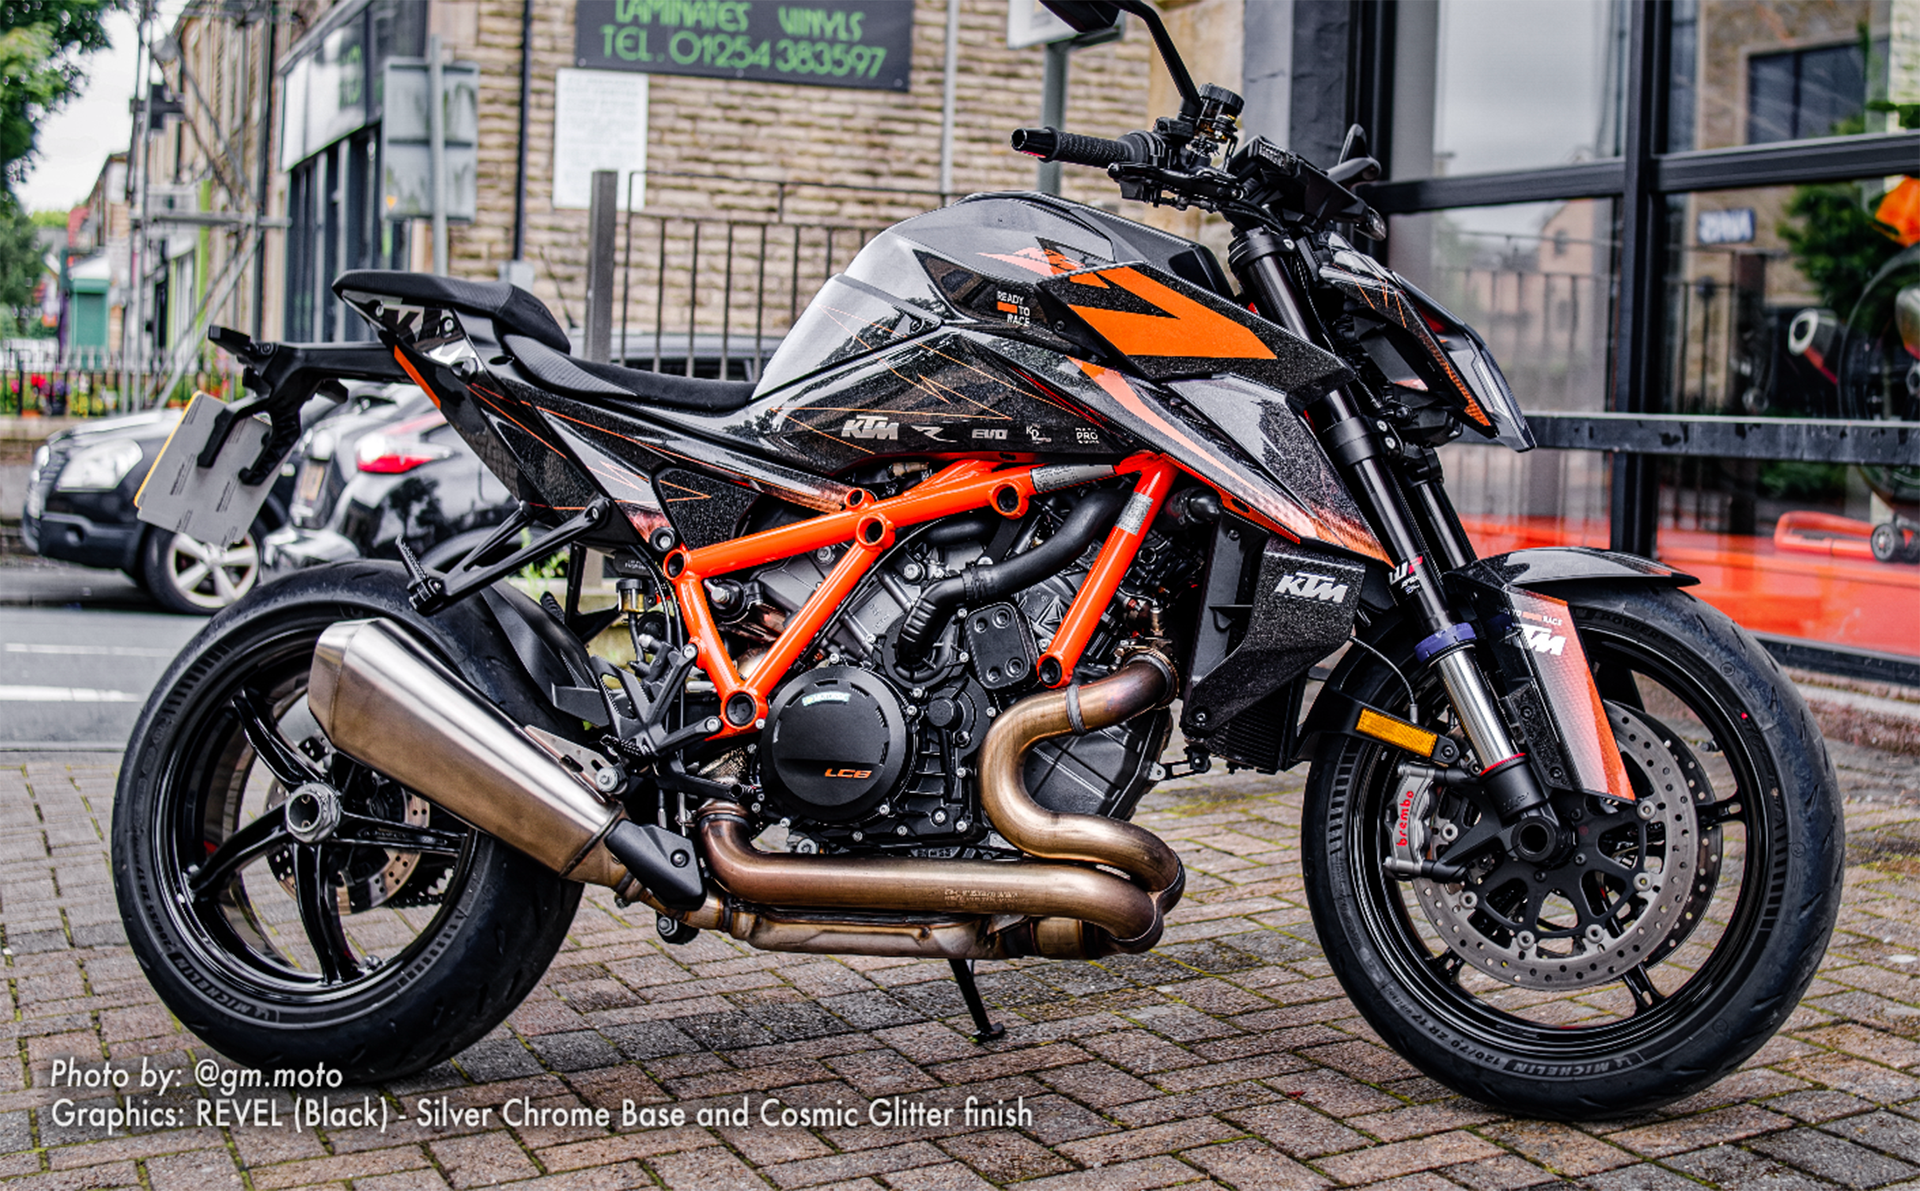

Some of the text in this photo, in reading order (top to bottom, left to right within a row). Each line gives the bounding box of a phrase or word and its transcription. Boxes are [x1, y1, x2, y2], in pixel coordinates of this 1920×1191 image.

[615, 0, 866, 42] LAMINATES VINYLS
[669, 30, 771, 69] 01254
[775, 38, 888, 79] 383597
[996, 290, 1025, 305] READY
[1007, 313, 1031, 327] RACE
[1018, 305, 1030, 317] TO
[841, 414, 900, 440] KTM
[971, 428, 1009, 440] EVO
[1076, 431, 1099, 440] PRO
[1273, 571, 1349, 603] KTM
[1542, 615, 1563, 627] RACE
[1599, 613, 1659, 640] POWER
[1396, 790, 1415, 847] brembo
[175, 957, 251, 1014] MICHELIN
[1450, 1037, 1501, 1067] 120/70
[1511, 1060, 1611, 1079] MICHELIN
